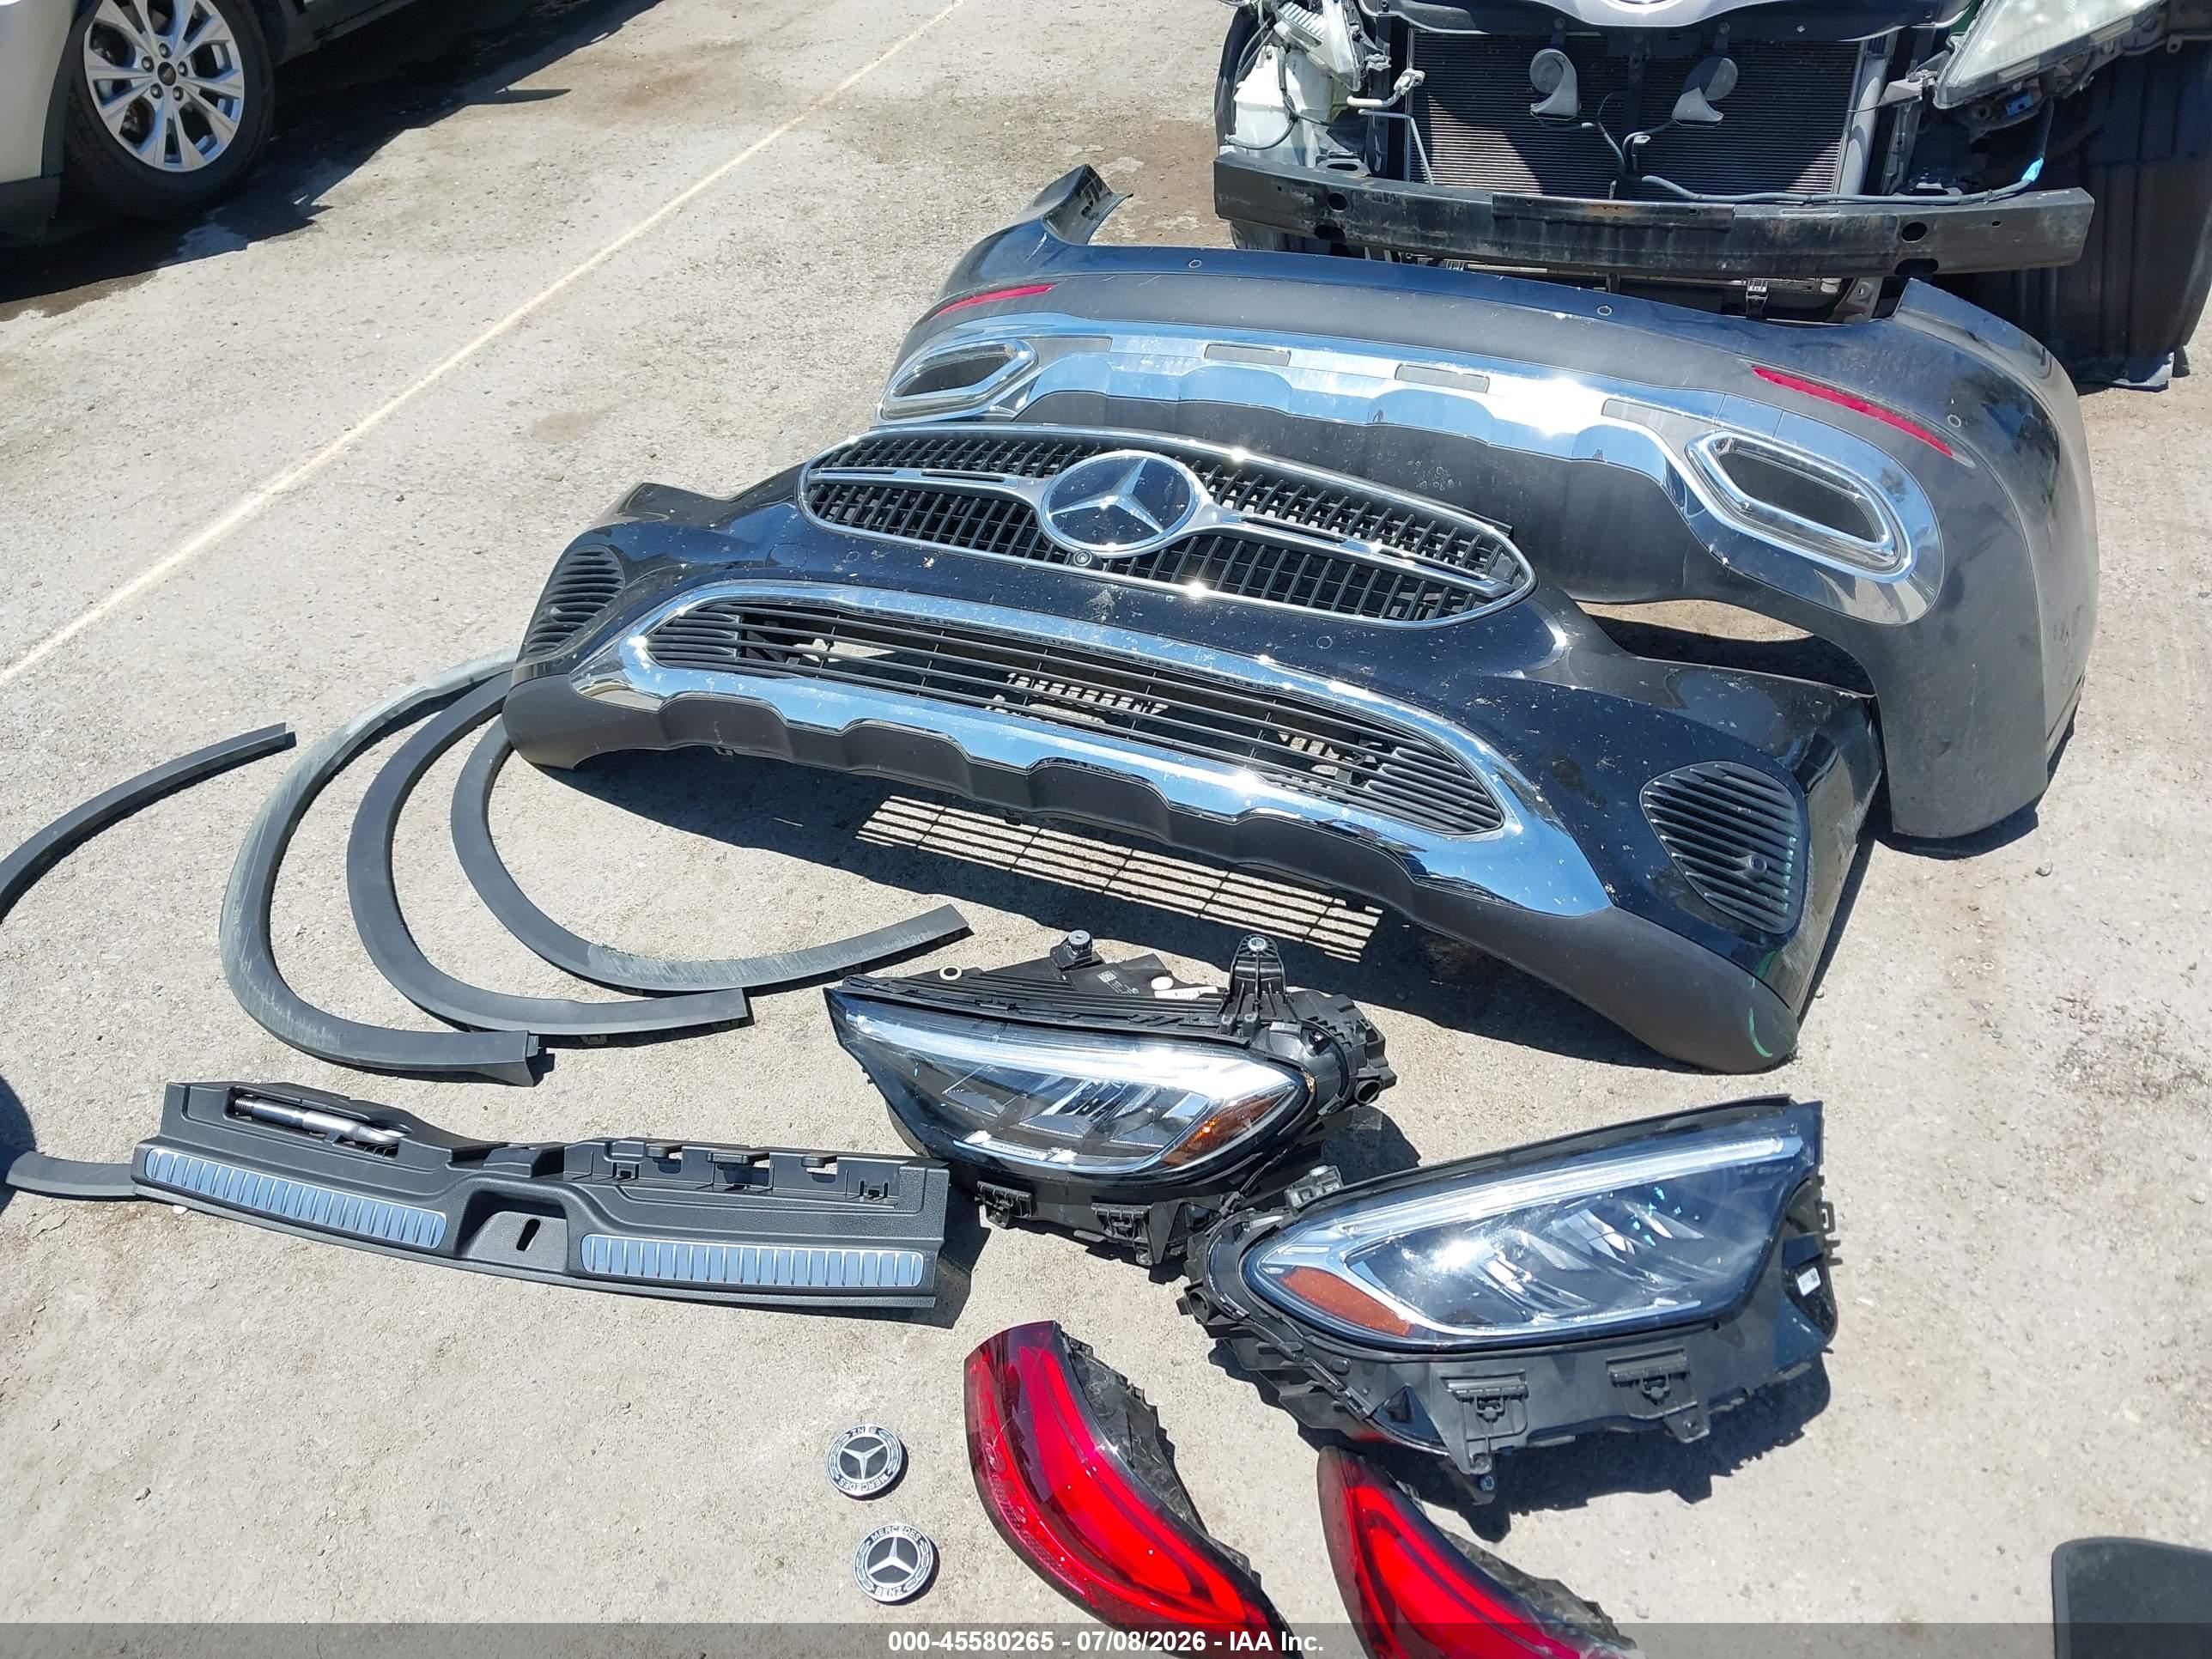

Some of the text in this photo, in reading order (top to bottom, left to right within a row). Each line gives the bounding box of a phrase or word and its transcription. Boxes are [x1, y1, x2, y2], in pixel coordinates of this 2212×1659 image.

[850, 1426, 878, 1437] BNZ
[871, 1525, 921, 1542] MERCEDES
[874, 1585, 903, 1597] BENZ
